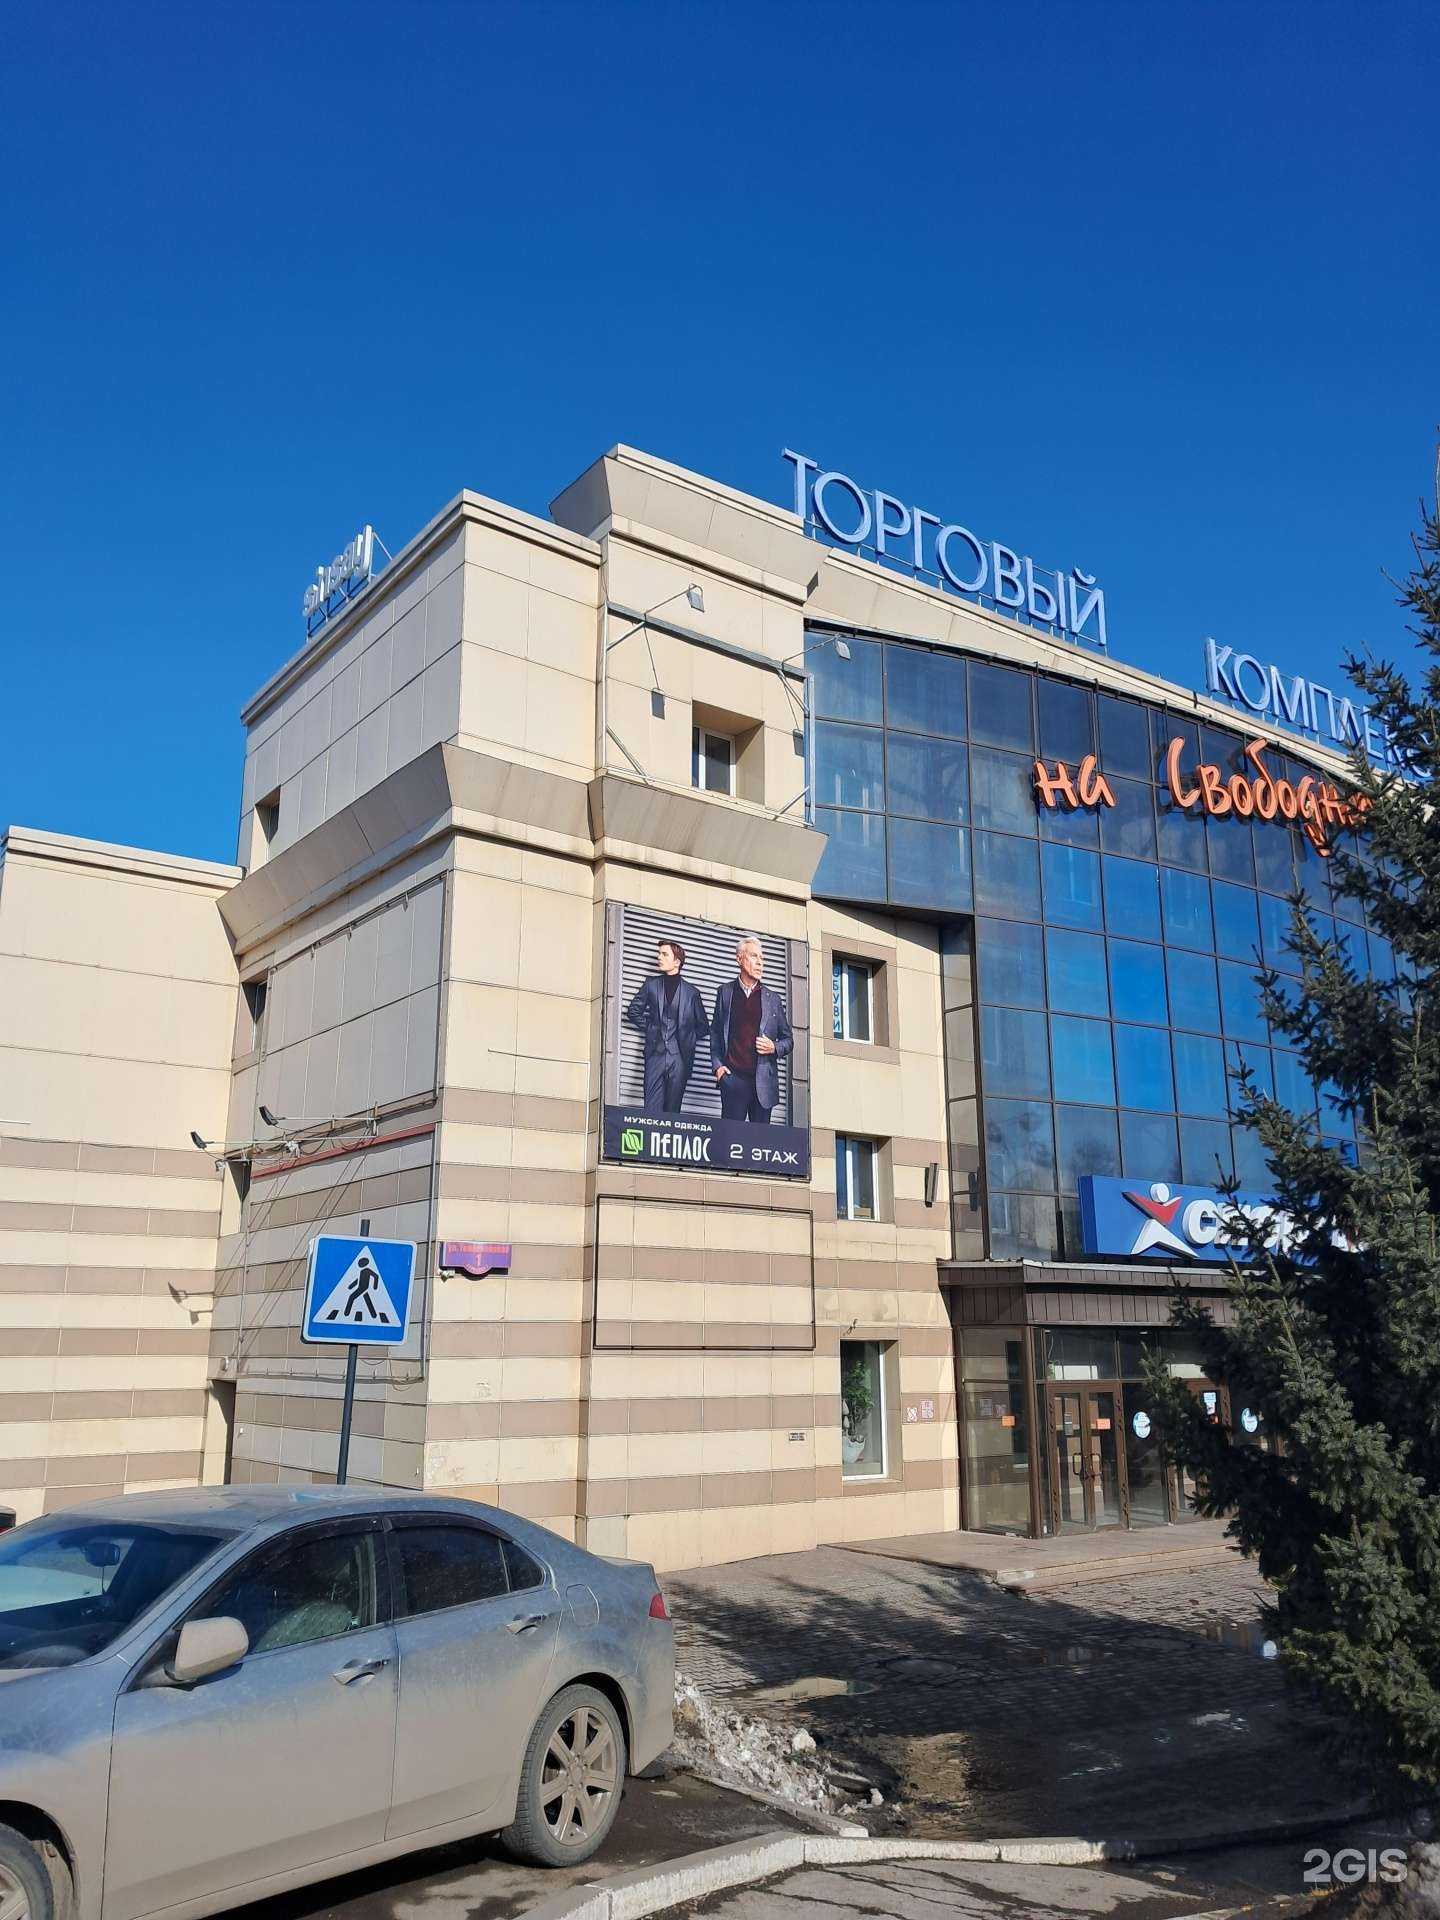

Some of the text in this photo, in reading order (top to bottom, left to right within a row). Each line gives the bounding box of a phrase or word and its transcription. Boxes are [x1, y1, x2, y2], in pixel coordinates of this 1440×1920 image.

[781, 447, 1107, 646] ТОРГОВЫЙ
[1033, 753, 1117, 810] на
[623, 1116, 713, 1132] МУЖСКАЯ ОДЕЖДА
[650, 1131, 712, 1162] ПЕПЛОС
[730, 1143, 799, 1165] 2 ЭТАЖ
